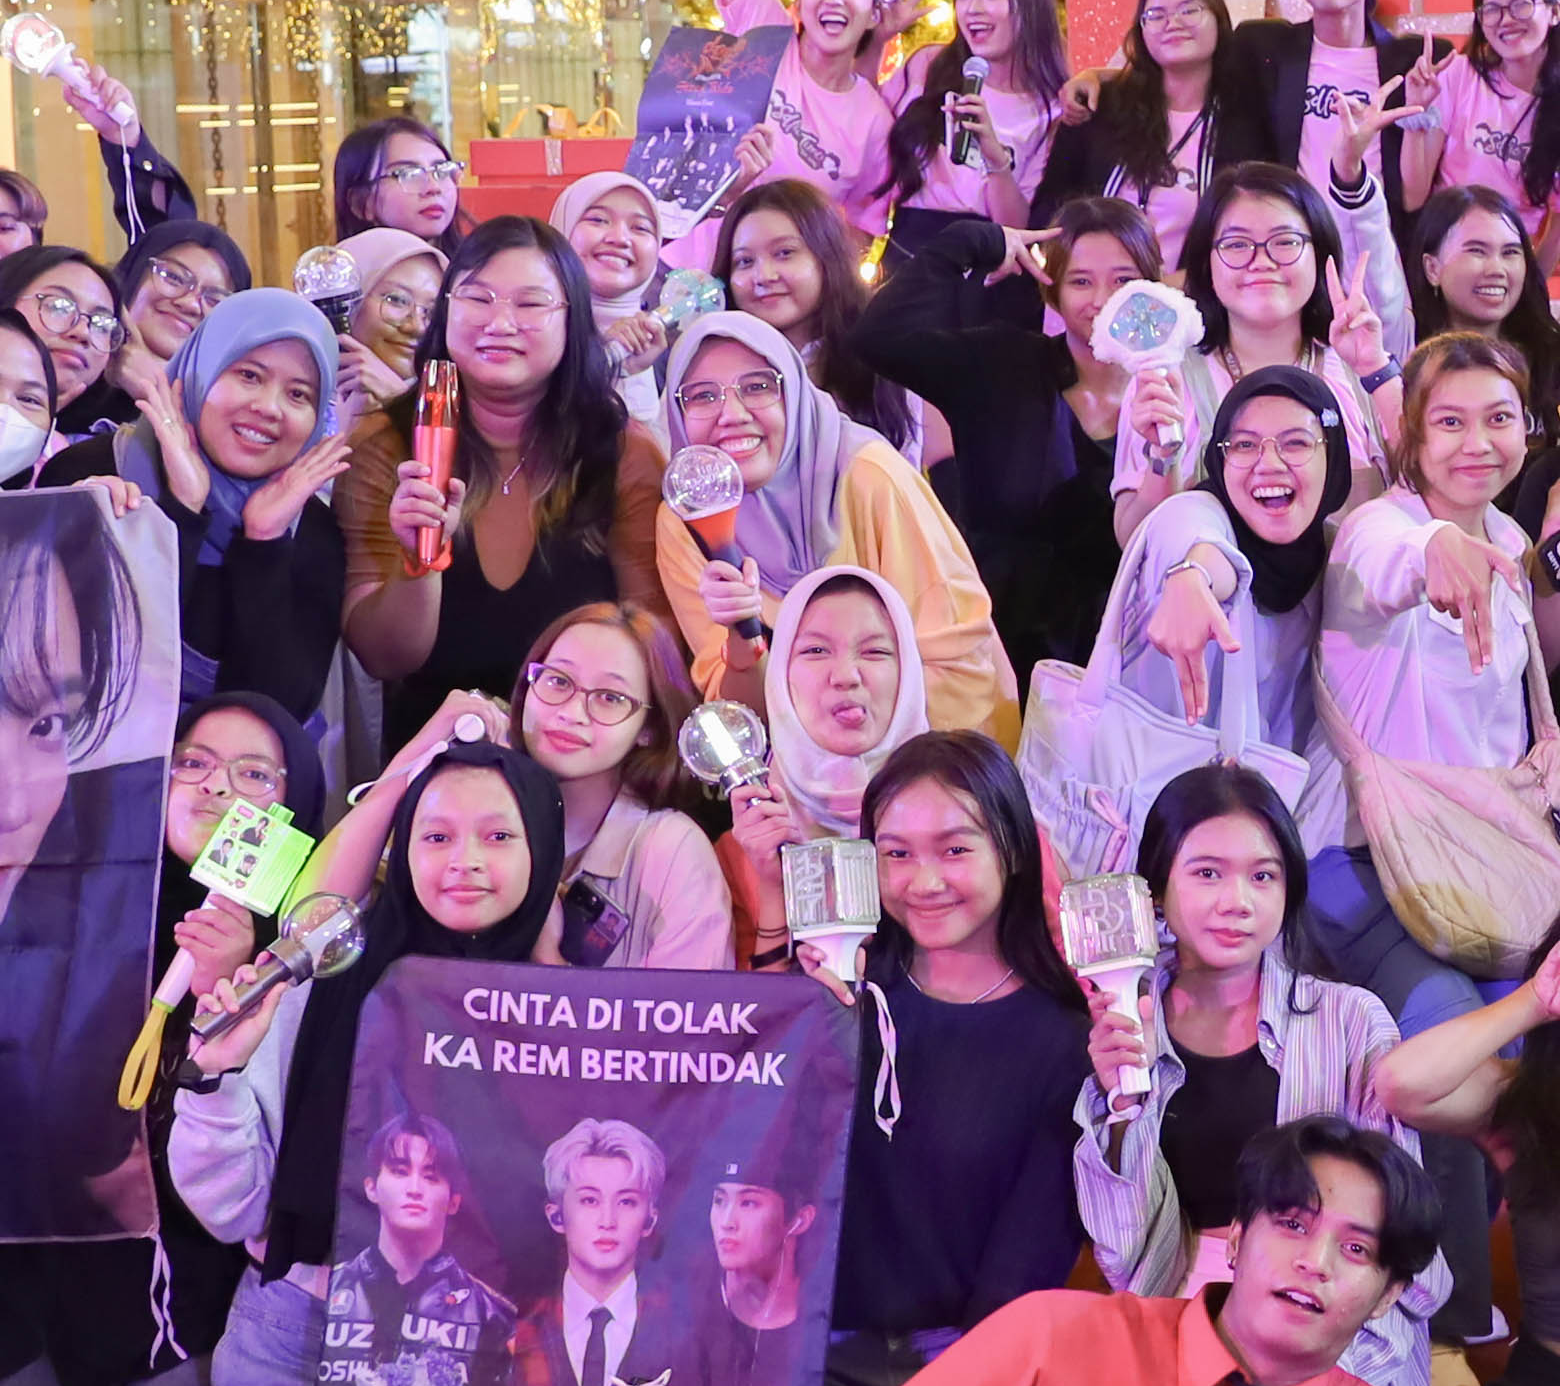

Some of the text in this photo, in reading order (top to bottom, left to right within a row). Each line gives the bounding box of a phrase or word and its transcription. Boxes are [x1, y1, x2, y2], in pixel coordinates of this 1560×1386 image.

[463, 987, 759, 1035] CINTA DI TOLAK
[424, 1032, 788, 1087] KA REM BERTINDAK
